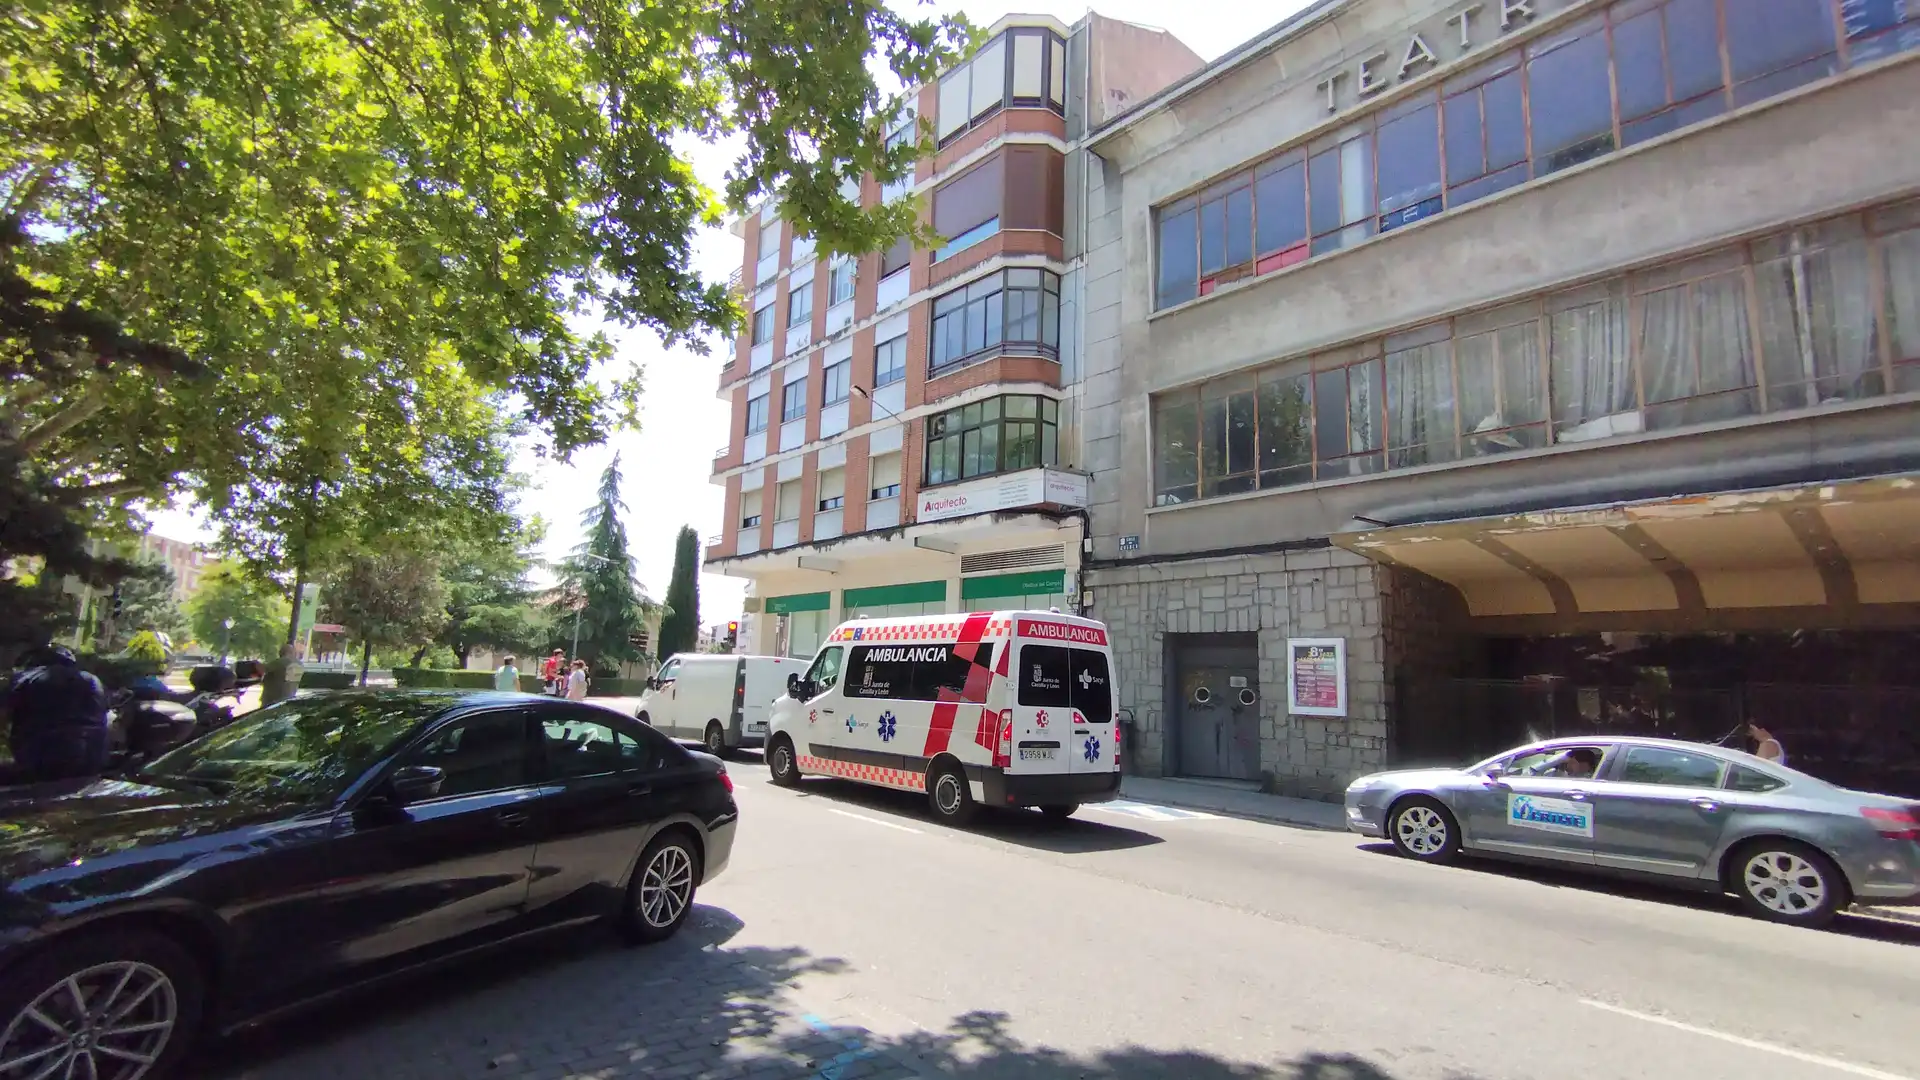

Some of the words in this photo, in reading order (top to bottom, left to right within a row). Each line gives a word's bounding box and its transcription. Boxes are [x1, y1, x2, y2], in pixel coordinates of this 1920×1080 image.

[924, 495, 967, 512] Arquitecto
[1028, 623, 1100, 643] AMBULANCIA
[864, 647, 947, 662] AMBULANCIA
[1024, 750, 1041, 759] 2958
